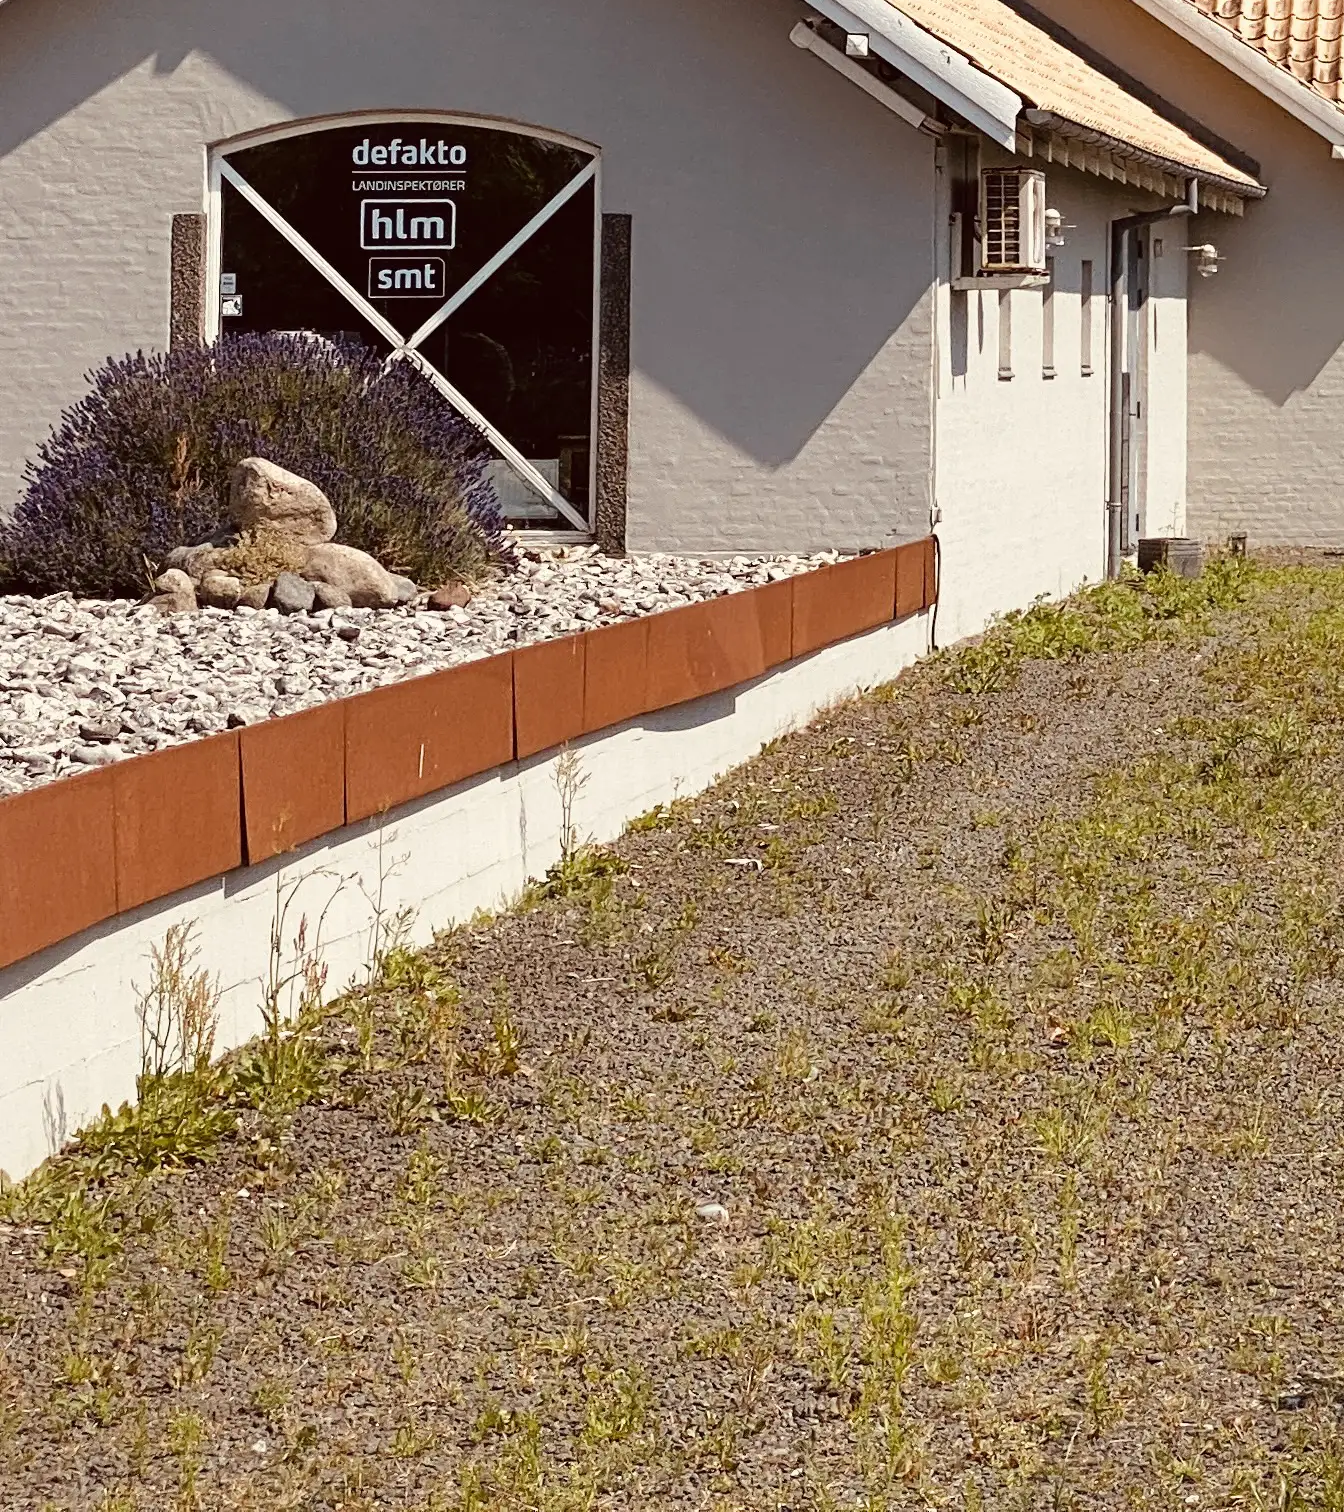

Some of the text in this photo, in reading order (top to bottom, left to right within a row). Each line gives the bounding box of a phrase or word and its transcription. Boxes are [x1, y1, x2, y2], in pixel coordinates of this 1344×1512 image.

[352, 139, 467, 165] defakto
[352, 180, 466, 191] LANDINSPEKTØRER
[371, 209, 445, 239] hlm
[377, 263, 436, 289] smt
